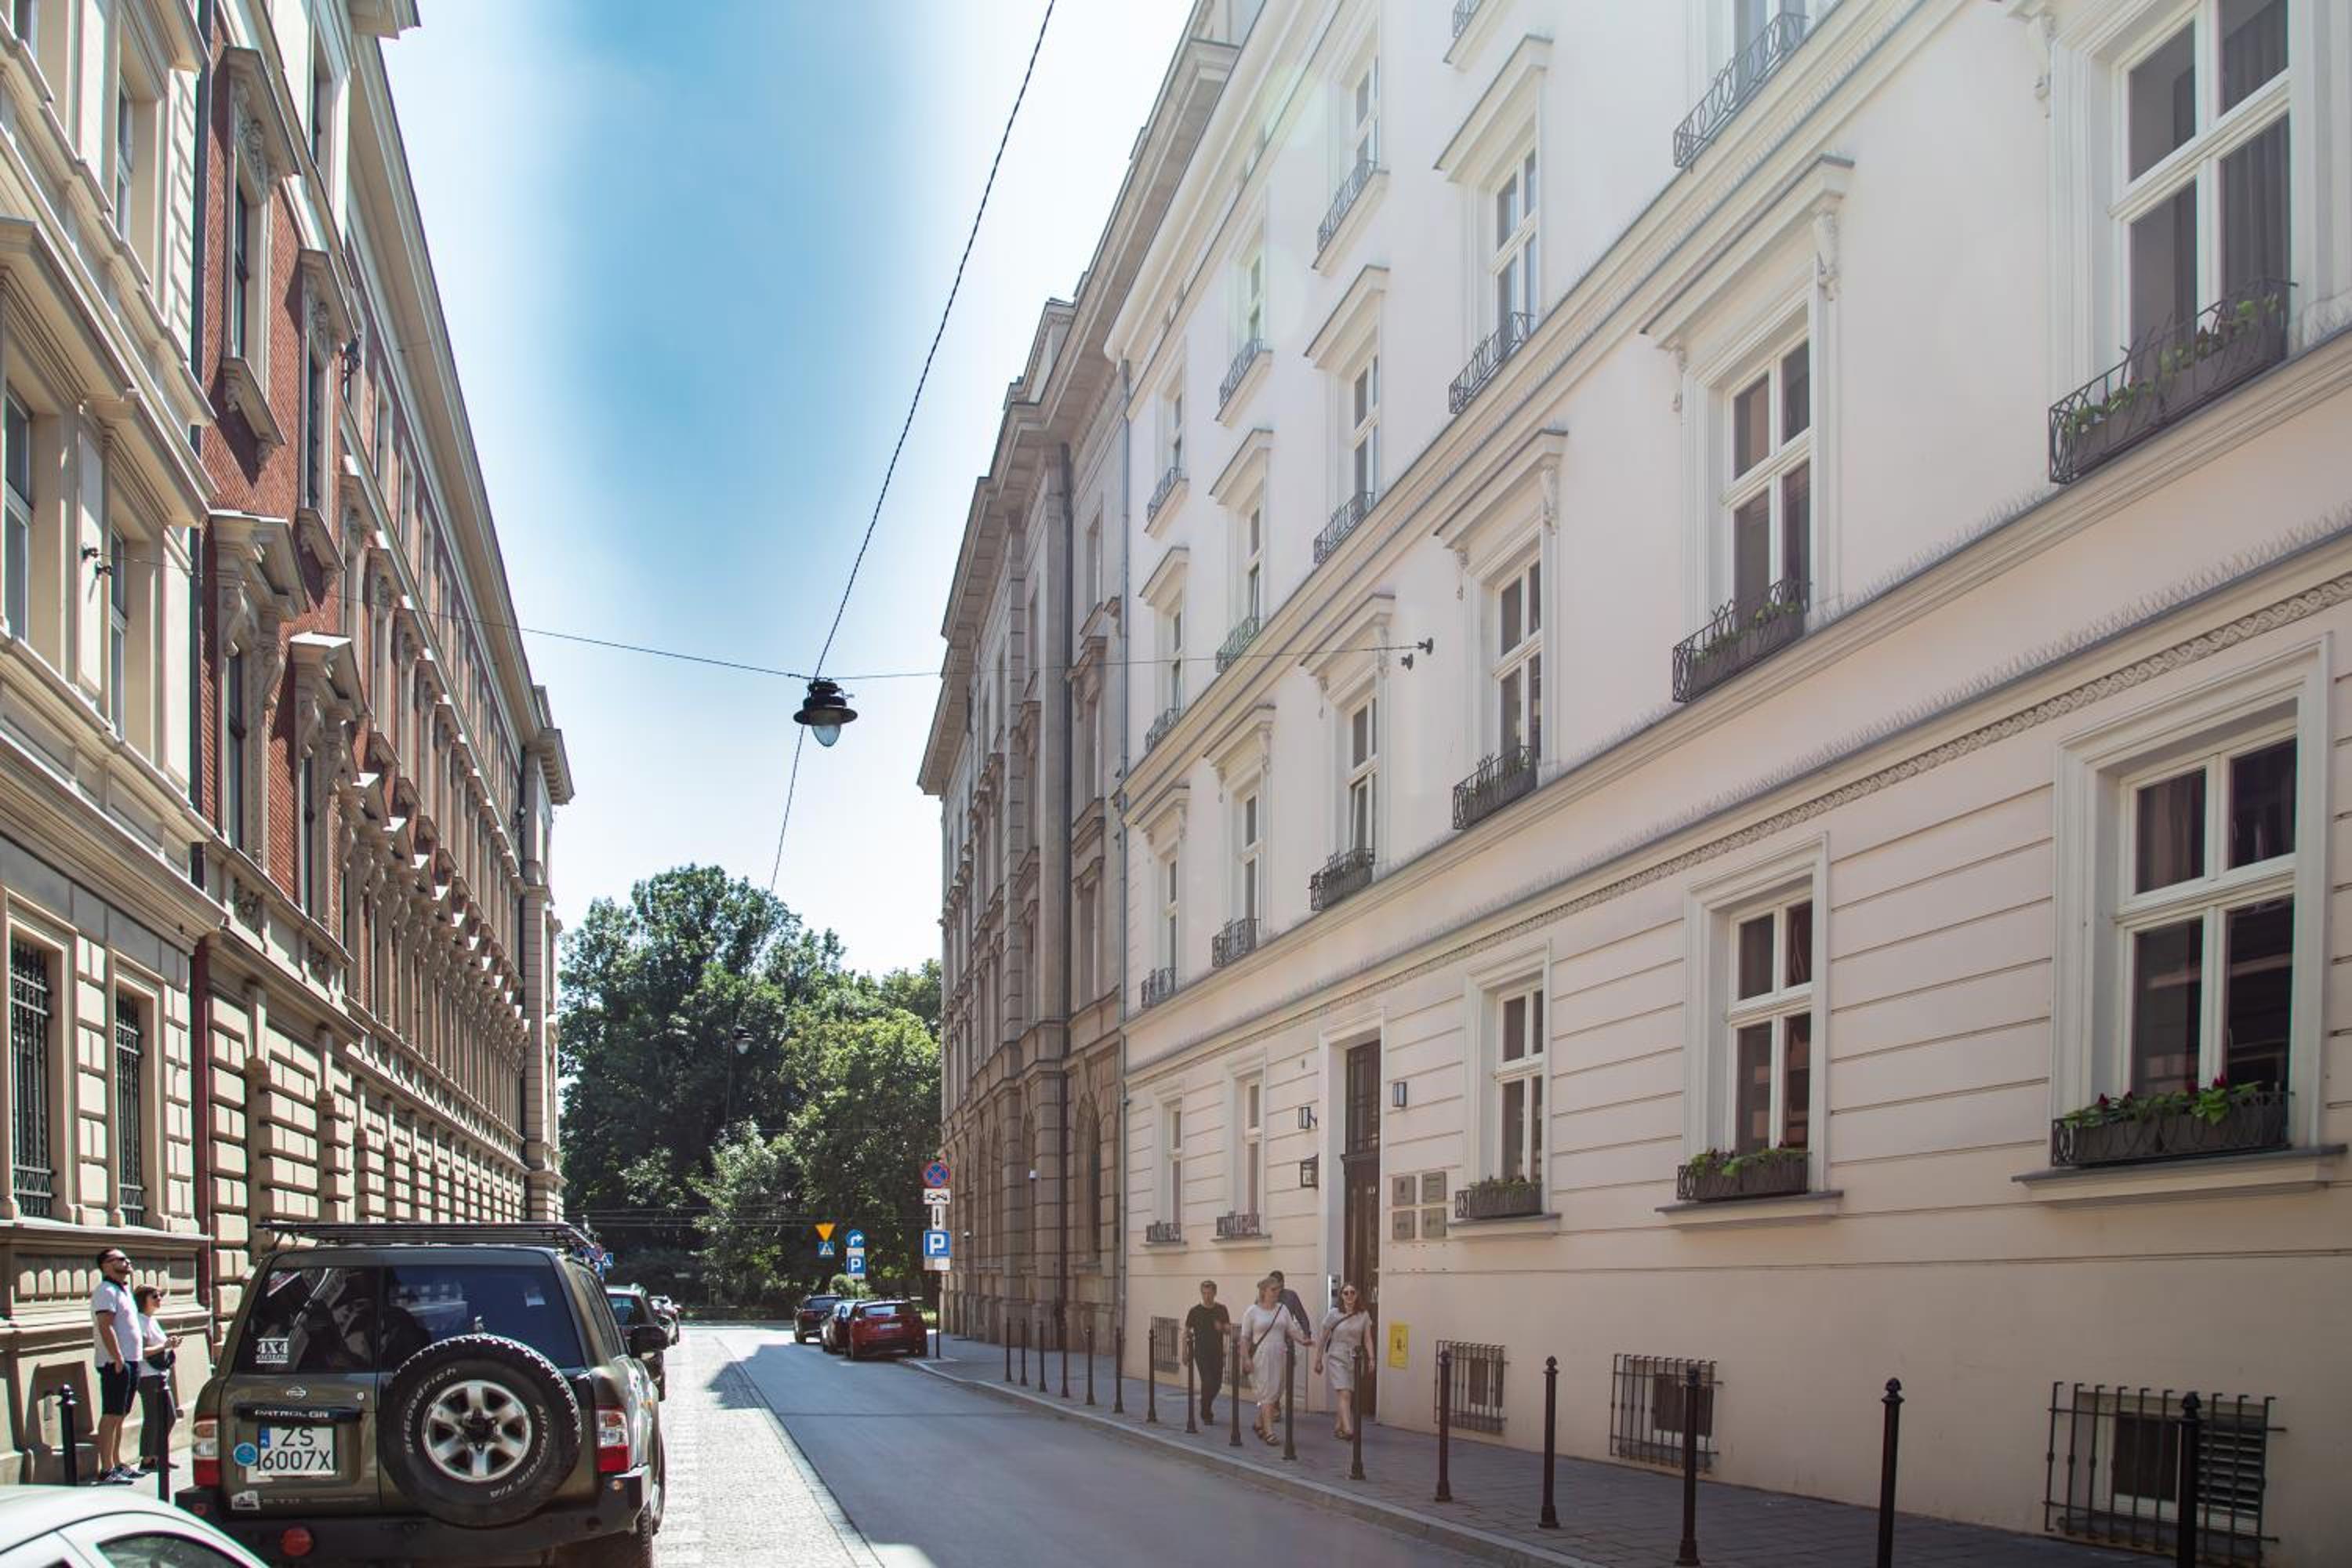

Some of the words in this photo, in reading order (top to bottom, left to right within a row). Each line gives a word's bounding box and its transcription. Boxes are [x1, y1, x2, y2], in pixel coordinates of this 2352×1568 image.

[930, 1234, 945, 1254] P
[851, 1258, 862, 1272] P
[256, 1341, 289, 1354] 4X4
[281, 1427, 314, 1446] ZS
[263, 1450, 331, 1470] 6007X
